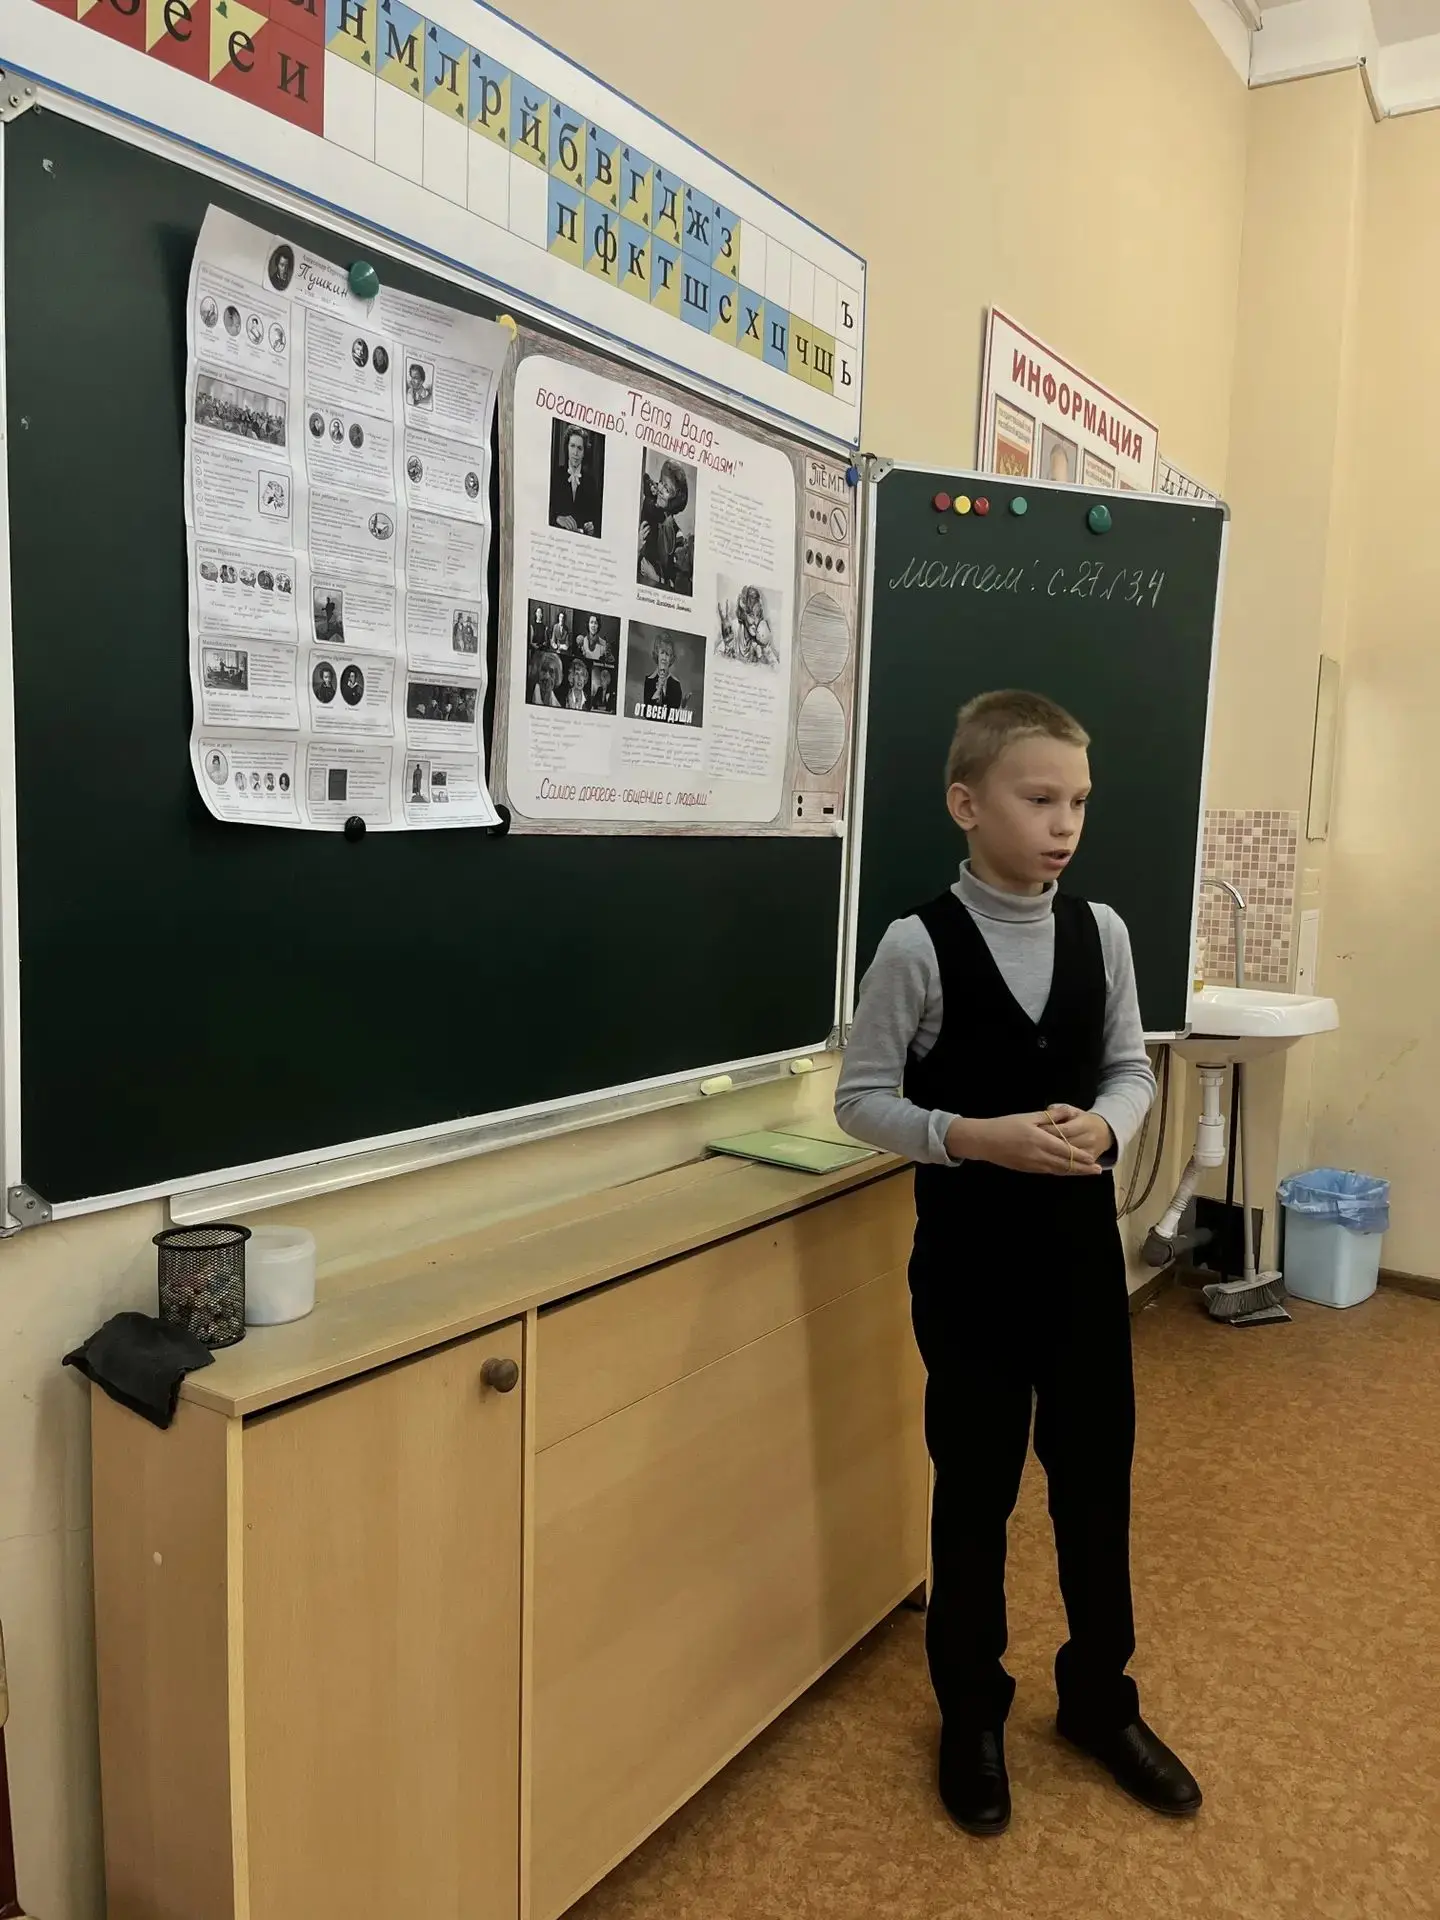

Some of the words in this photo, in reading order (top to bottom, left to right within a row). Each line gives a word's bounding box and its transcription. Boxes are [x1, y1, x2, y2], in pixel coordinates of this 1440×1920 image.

[336, 0, 367, 44] н
[385, 20, 418, 72] м
[434, 51, 460, 96] л
[478, 74, 502, 127] р
[519, 95, 542, 153] й
[558, 122, 579, 172] б
[596, 147, 613, 185] в
[629, 169, 645, 202] г
[659, 187, 678, 223] д
[686, 205, 710, 246] ж
[720, 226, 733, 258] з
[841, 300, 854, 329] ъ
[228, 30, 255, 73] е
[277, 52, 310, 103] и
[555, 202, 578, 244] п
[594, 213, 617, 275] ф
[628, 241, 646, 280] к
[657, 255, 674, 289] т
[683, 273, 709, 313] ш
[718, 294, 732, 324] с
[745, 307, 760, 340] х
[770, 321, 786, 360] ц
[795, 334, 809, 366] ч
[813, 344, 834, 384] щ
[840, 359, 852, 386] ь
[297, 262, 349, 298] Пушкин
[1011, 348, 1143, 464] ИНФОРМАЦИЯ
[635, 423, 695, 460] отданное
[634, 702, 646, 717] ОТ
[645, 704, 667, 720] ВСЕЙ
[667, 707, 693, 724] ДУШИ
[665, 791, 672, 805] с
